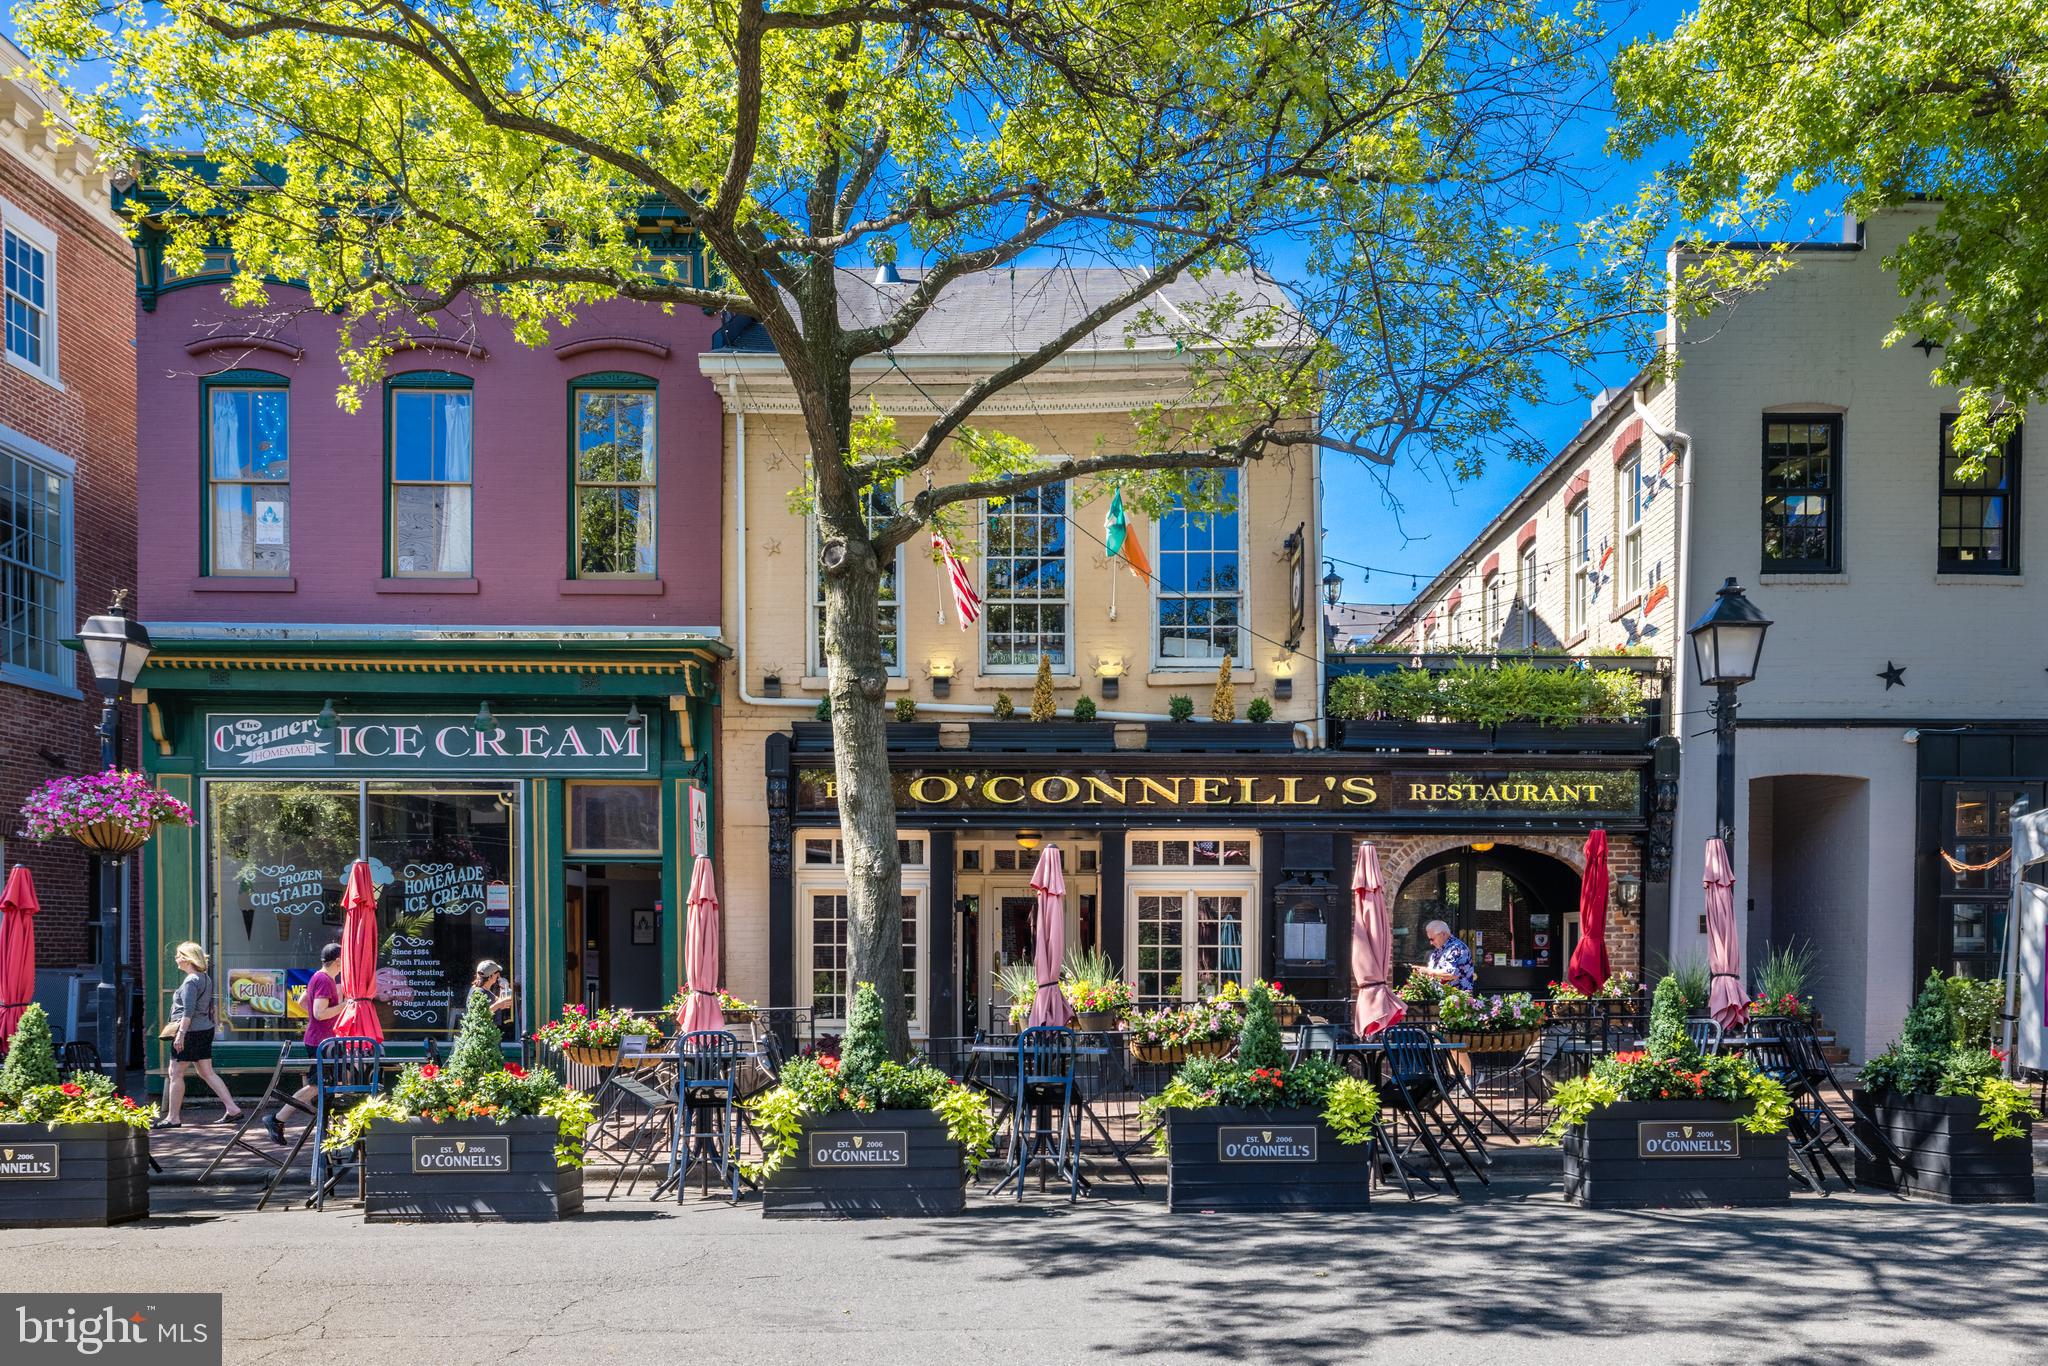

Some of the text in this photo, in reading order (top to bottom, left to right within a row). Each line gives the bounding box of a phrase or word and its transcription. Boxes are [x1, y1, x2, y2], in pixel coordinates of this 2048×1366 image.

[240, 721, 258, 729] The
[214, 719, 321, 752] Creamery
[336, 725, 642, 758] ICE CREAM
[254, 744, 314, 760] HOMEMADE
[908, 775, 1377, 804] O'CONNELL'S
[1409, 783, 1603, 801] RESTAURANT
[278, 870, 322, 887] FROZEN
[404, 866, 485, 894] HOMEMADE
[250, 883, 323, 906] CUSTARD
[404, 895, 428, 912] ICE
[431, 883, 485, 906] CREAM
[417, 969, 444, 977] Seating
[392, 990, 412, 998] Dairy
